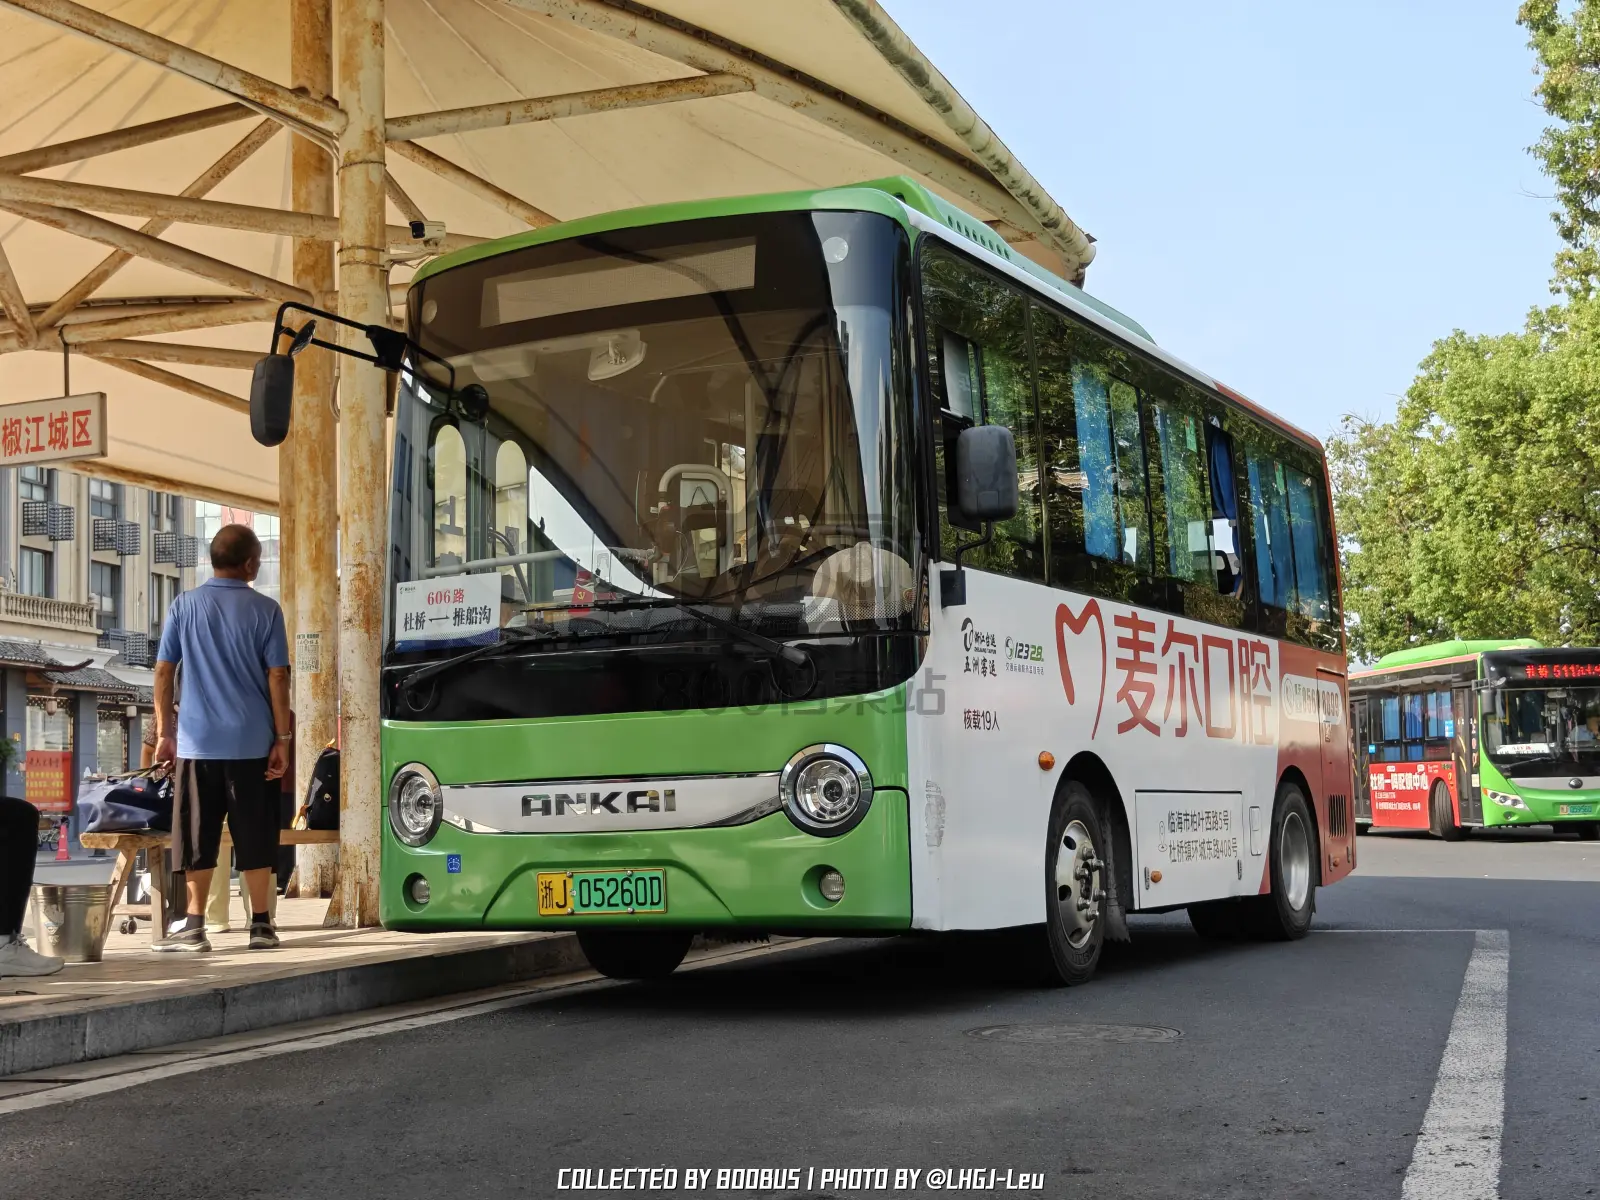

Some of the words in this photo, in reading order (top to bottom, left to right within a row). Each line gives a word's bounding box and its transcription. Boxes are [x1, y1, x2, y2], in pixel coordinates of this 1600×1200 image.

[2, 409, 92, 457] 椒江城区
[427, 588, 465, 606] 606路
[403, 611, 426, 632] 杜桥
[453, 605, 492, 627] 推船沟
[1014, 642, 1043, 661] 12328
[1113, 611, 1274, 745] 麦尔口腔
[963, 708, 1001, 731] 核载19人
[521, 789, 677, 817] ANKAI
